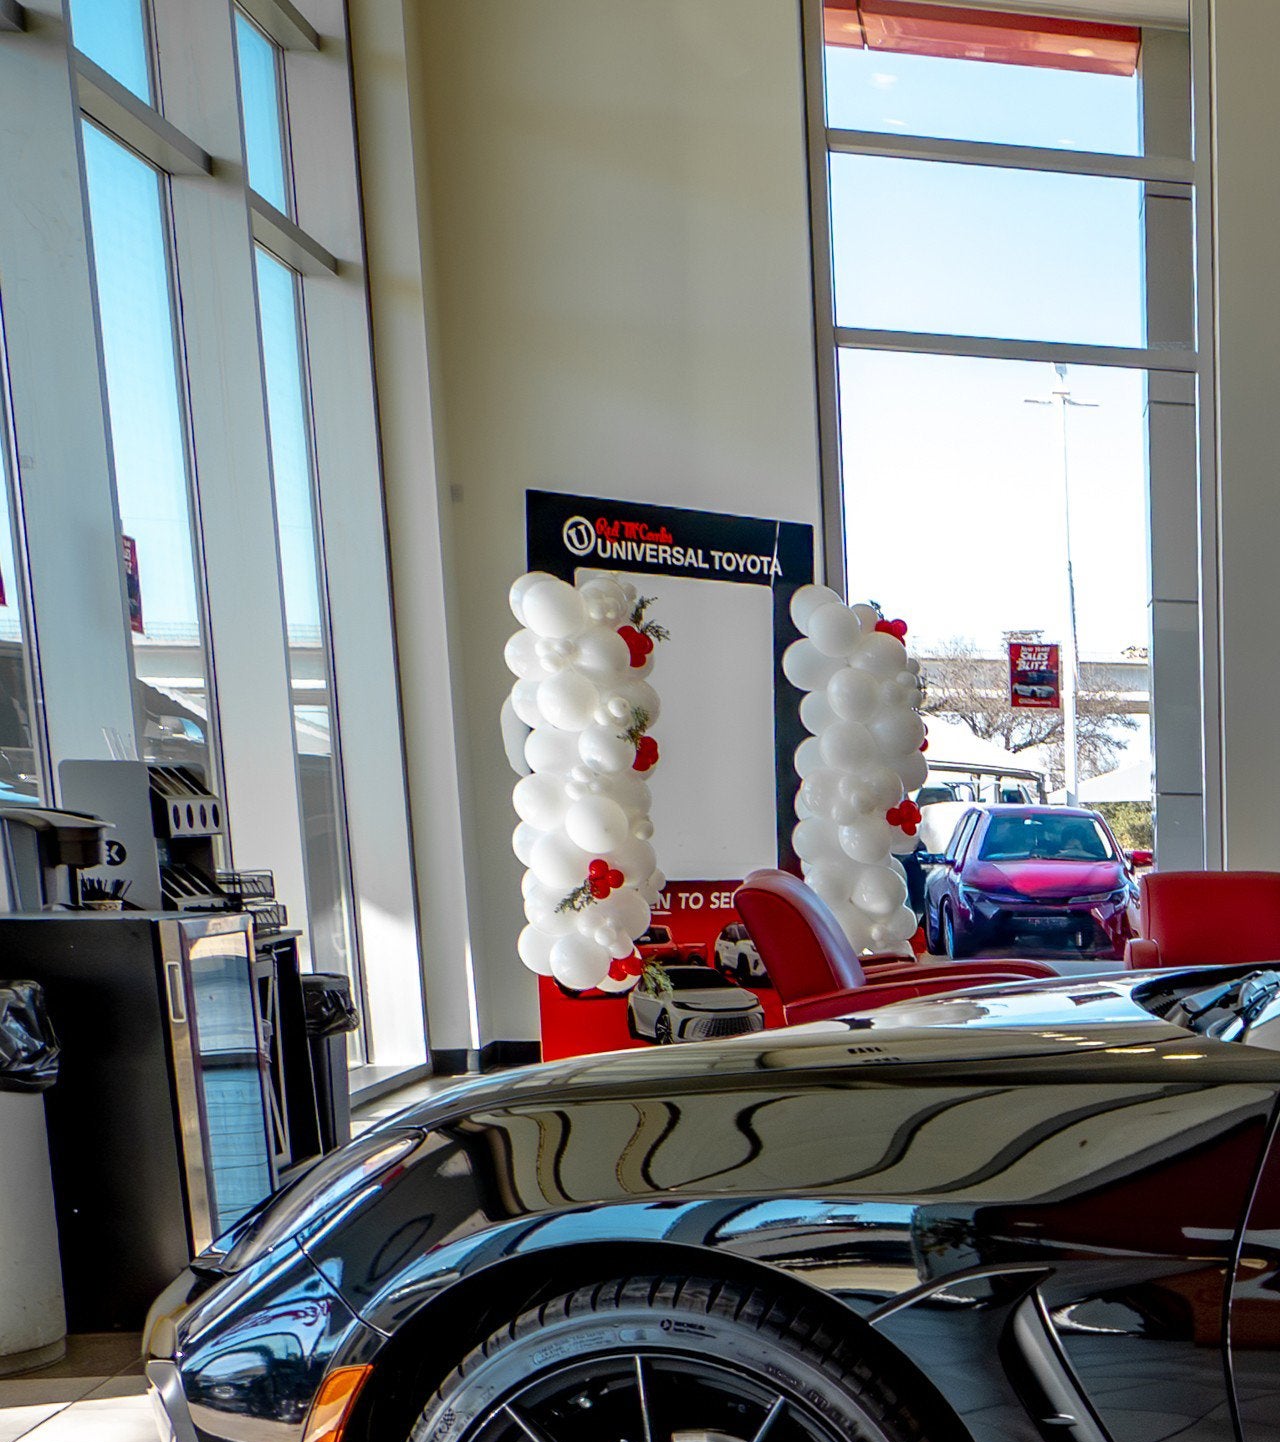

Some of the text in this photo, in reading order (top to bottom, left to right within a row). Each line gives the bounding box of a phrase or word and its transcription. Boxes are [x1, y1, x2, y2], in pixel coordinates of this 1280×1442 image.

[596, 538, 783, 577] UNIVERSAL TOYOTA
[678, 892, 704, 909] TO
